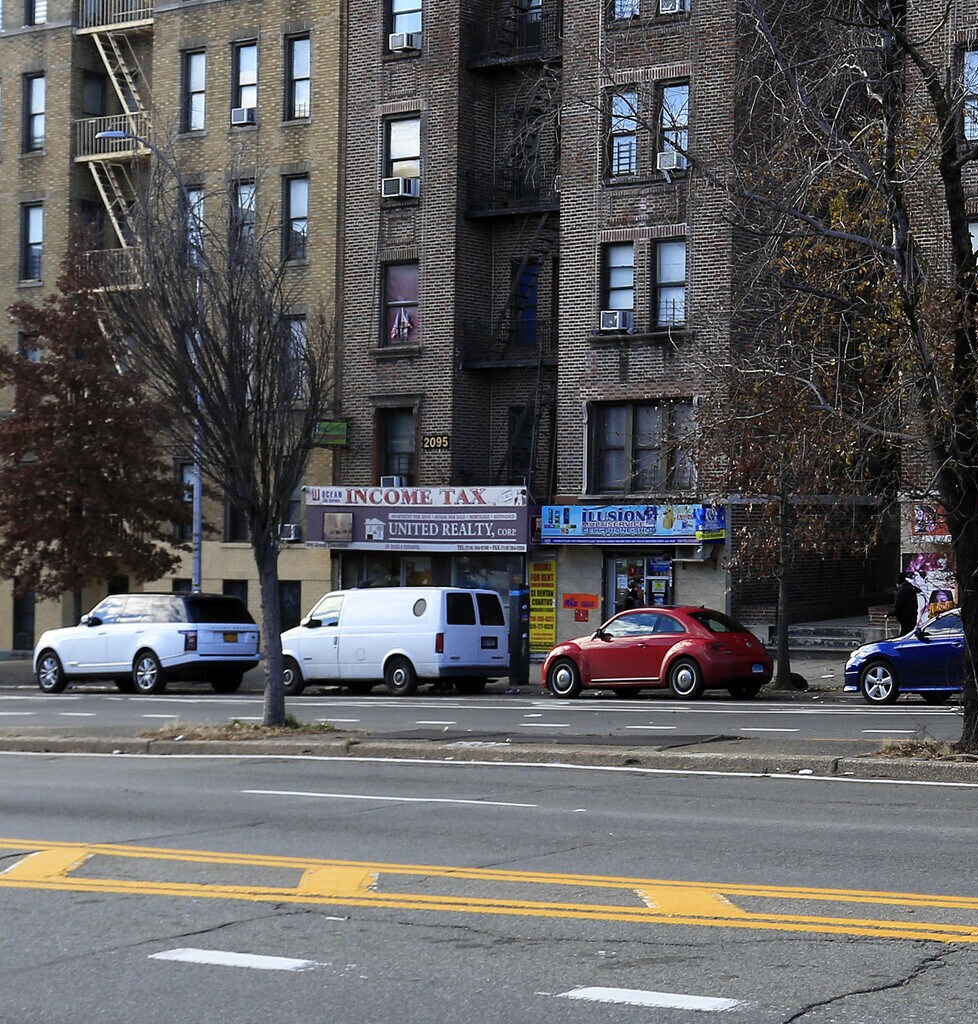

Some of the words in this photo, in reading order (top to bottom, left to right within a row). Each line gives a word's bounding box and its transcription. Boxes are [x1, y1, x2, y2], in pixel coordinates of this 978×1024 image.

[423, 436, 449, 448] 2095
[321, 490, 342, 499] OCEAN
[345, 488, 433, 505] INCOME
[439, 488, 487, 505] TAX
[388, 522, 438, 536] UNITED
[442, 522, 495, 538] REALTY,
